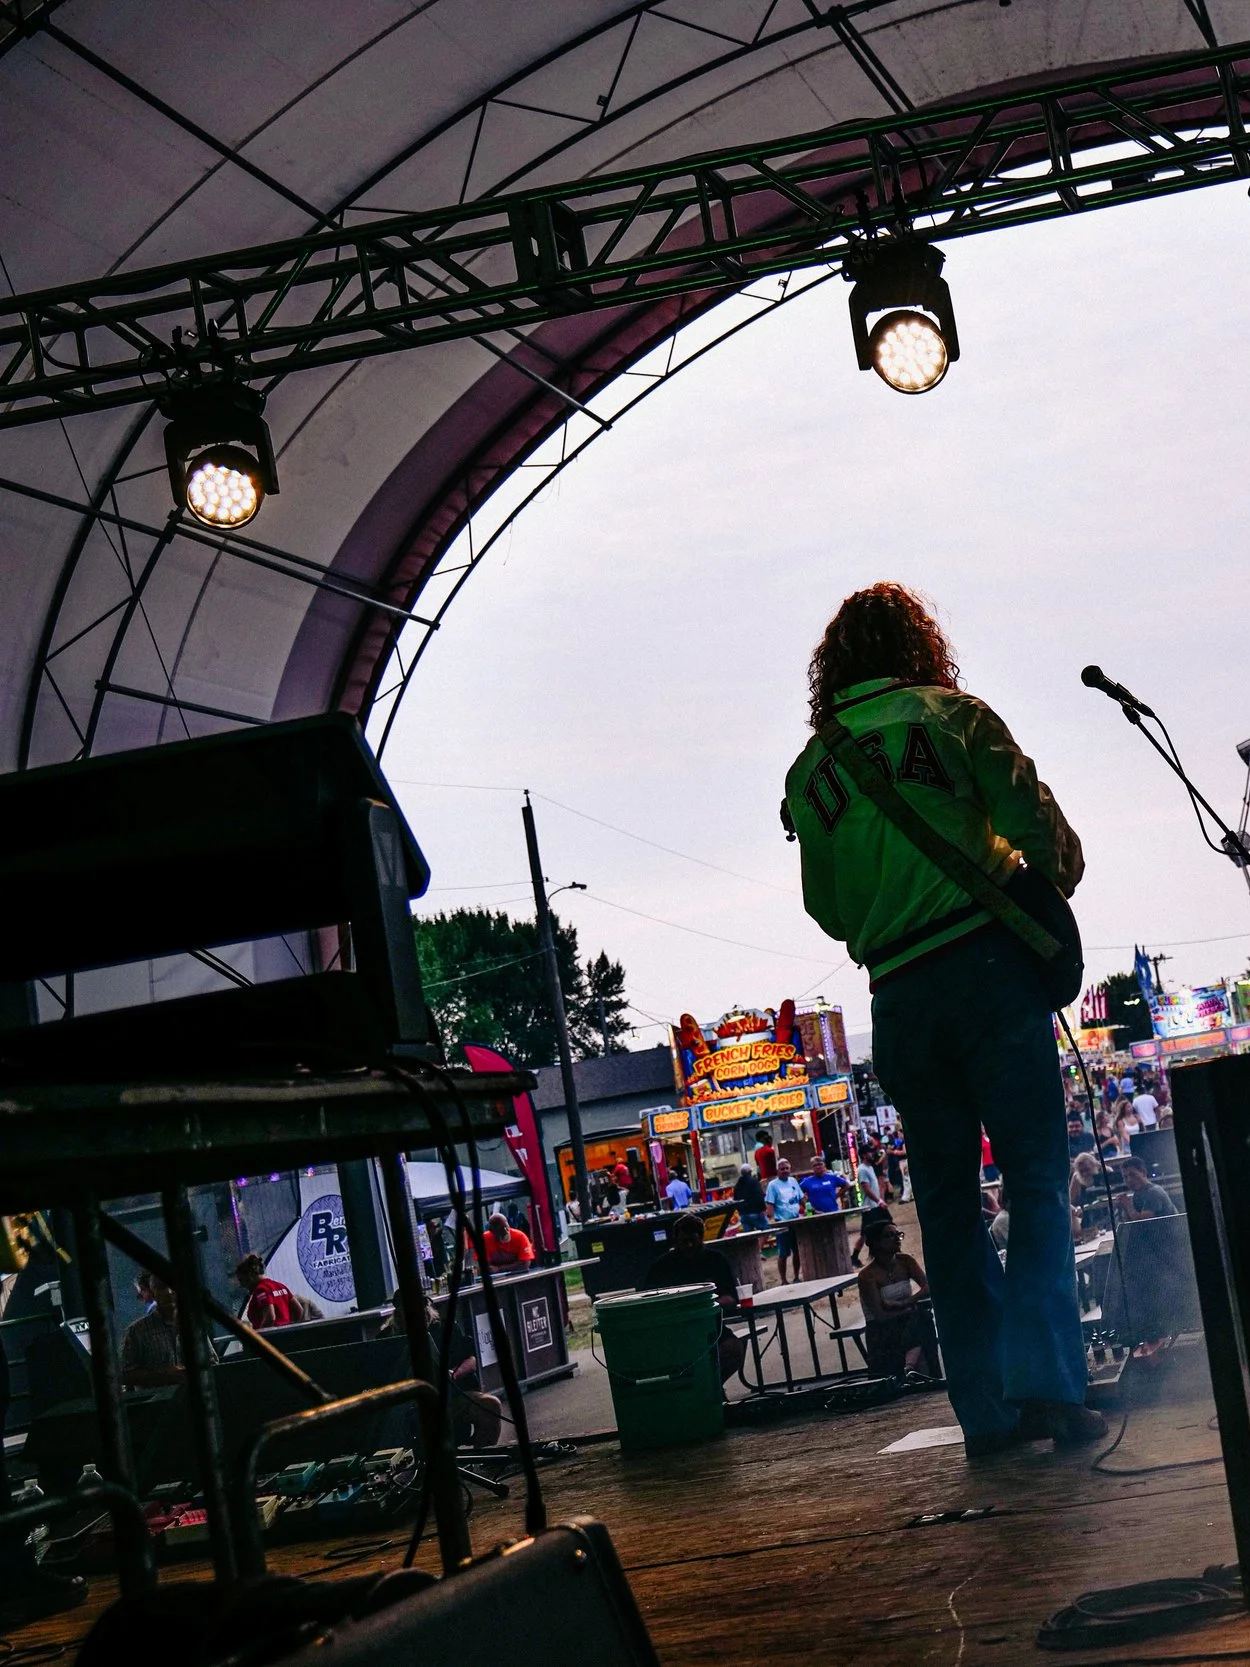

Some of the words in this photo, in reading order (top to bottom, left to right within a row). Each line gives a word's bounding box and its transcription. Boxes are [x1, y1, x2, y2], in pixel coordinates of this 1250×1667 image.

[694, 1045, 750, 1075] FRENCH
[752, 1043, 795, 1059] FRIES
[715, 1062, 747, 1080] CORN
[748, 1058, 779, 1074] DOGS
[704, 1090, 804, 1120] BUCKET-O-FRIES
